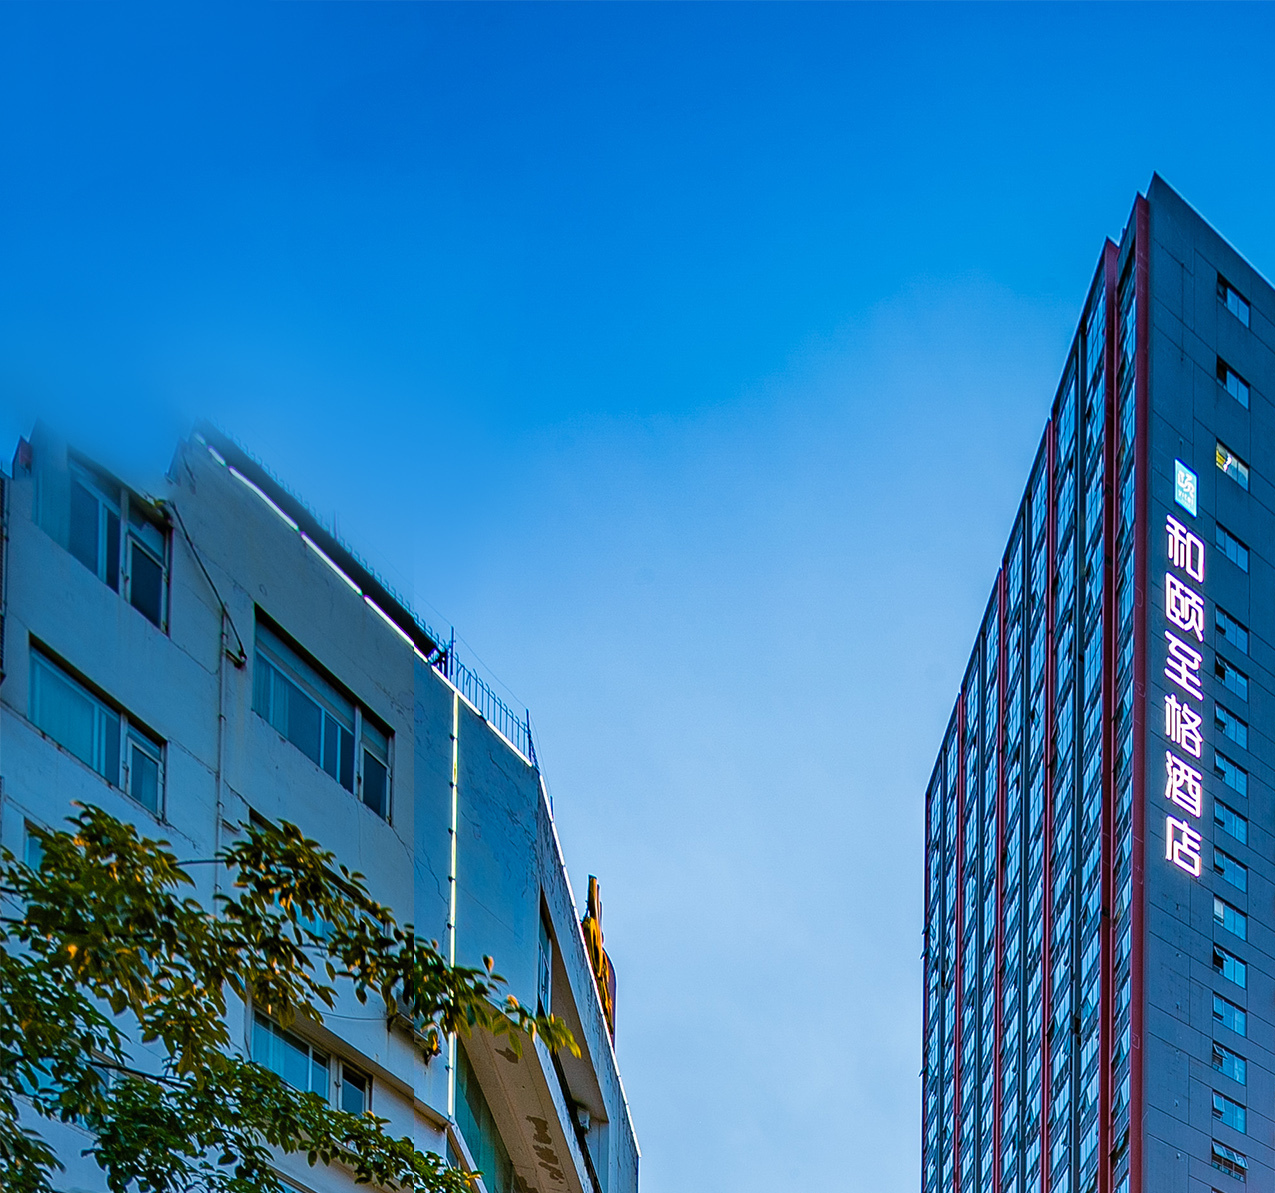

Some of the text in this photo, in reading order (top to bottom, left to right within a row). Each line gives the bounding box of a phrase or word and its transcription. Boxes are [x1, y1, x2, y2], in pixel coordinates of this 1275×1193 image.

[1164, 512, 1205, 878] 和颐至格酒店
